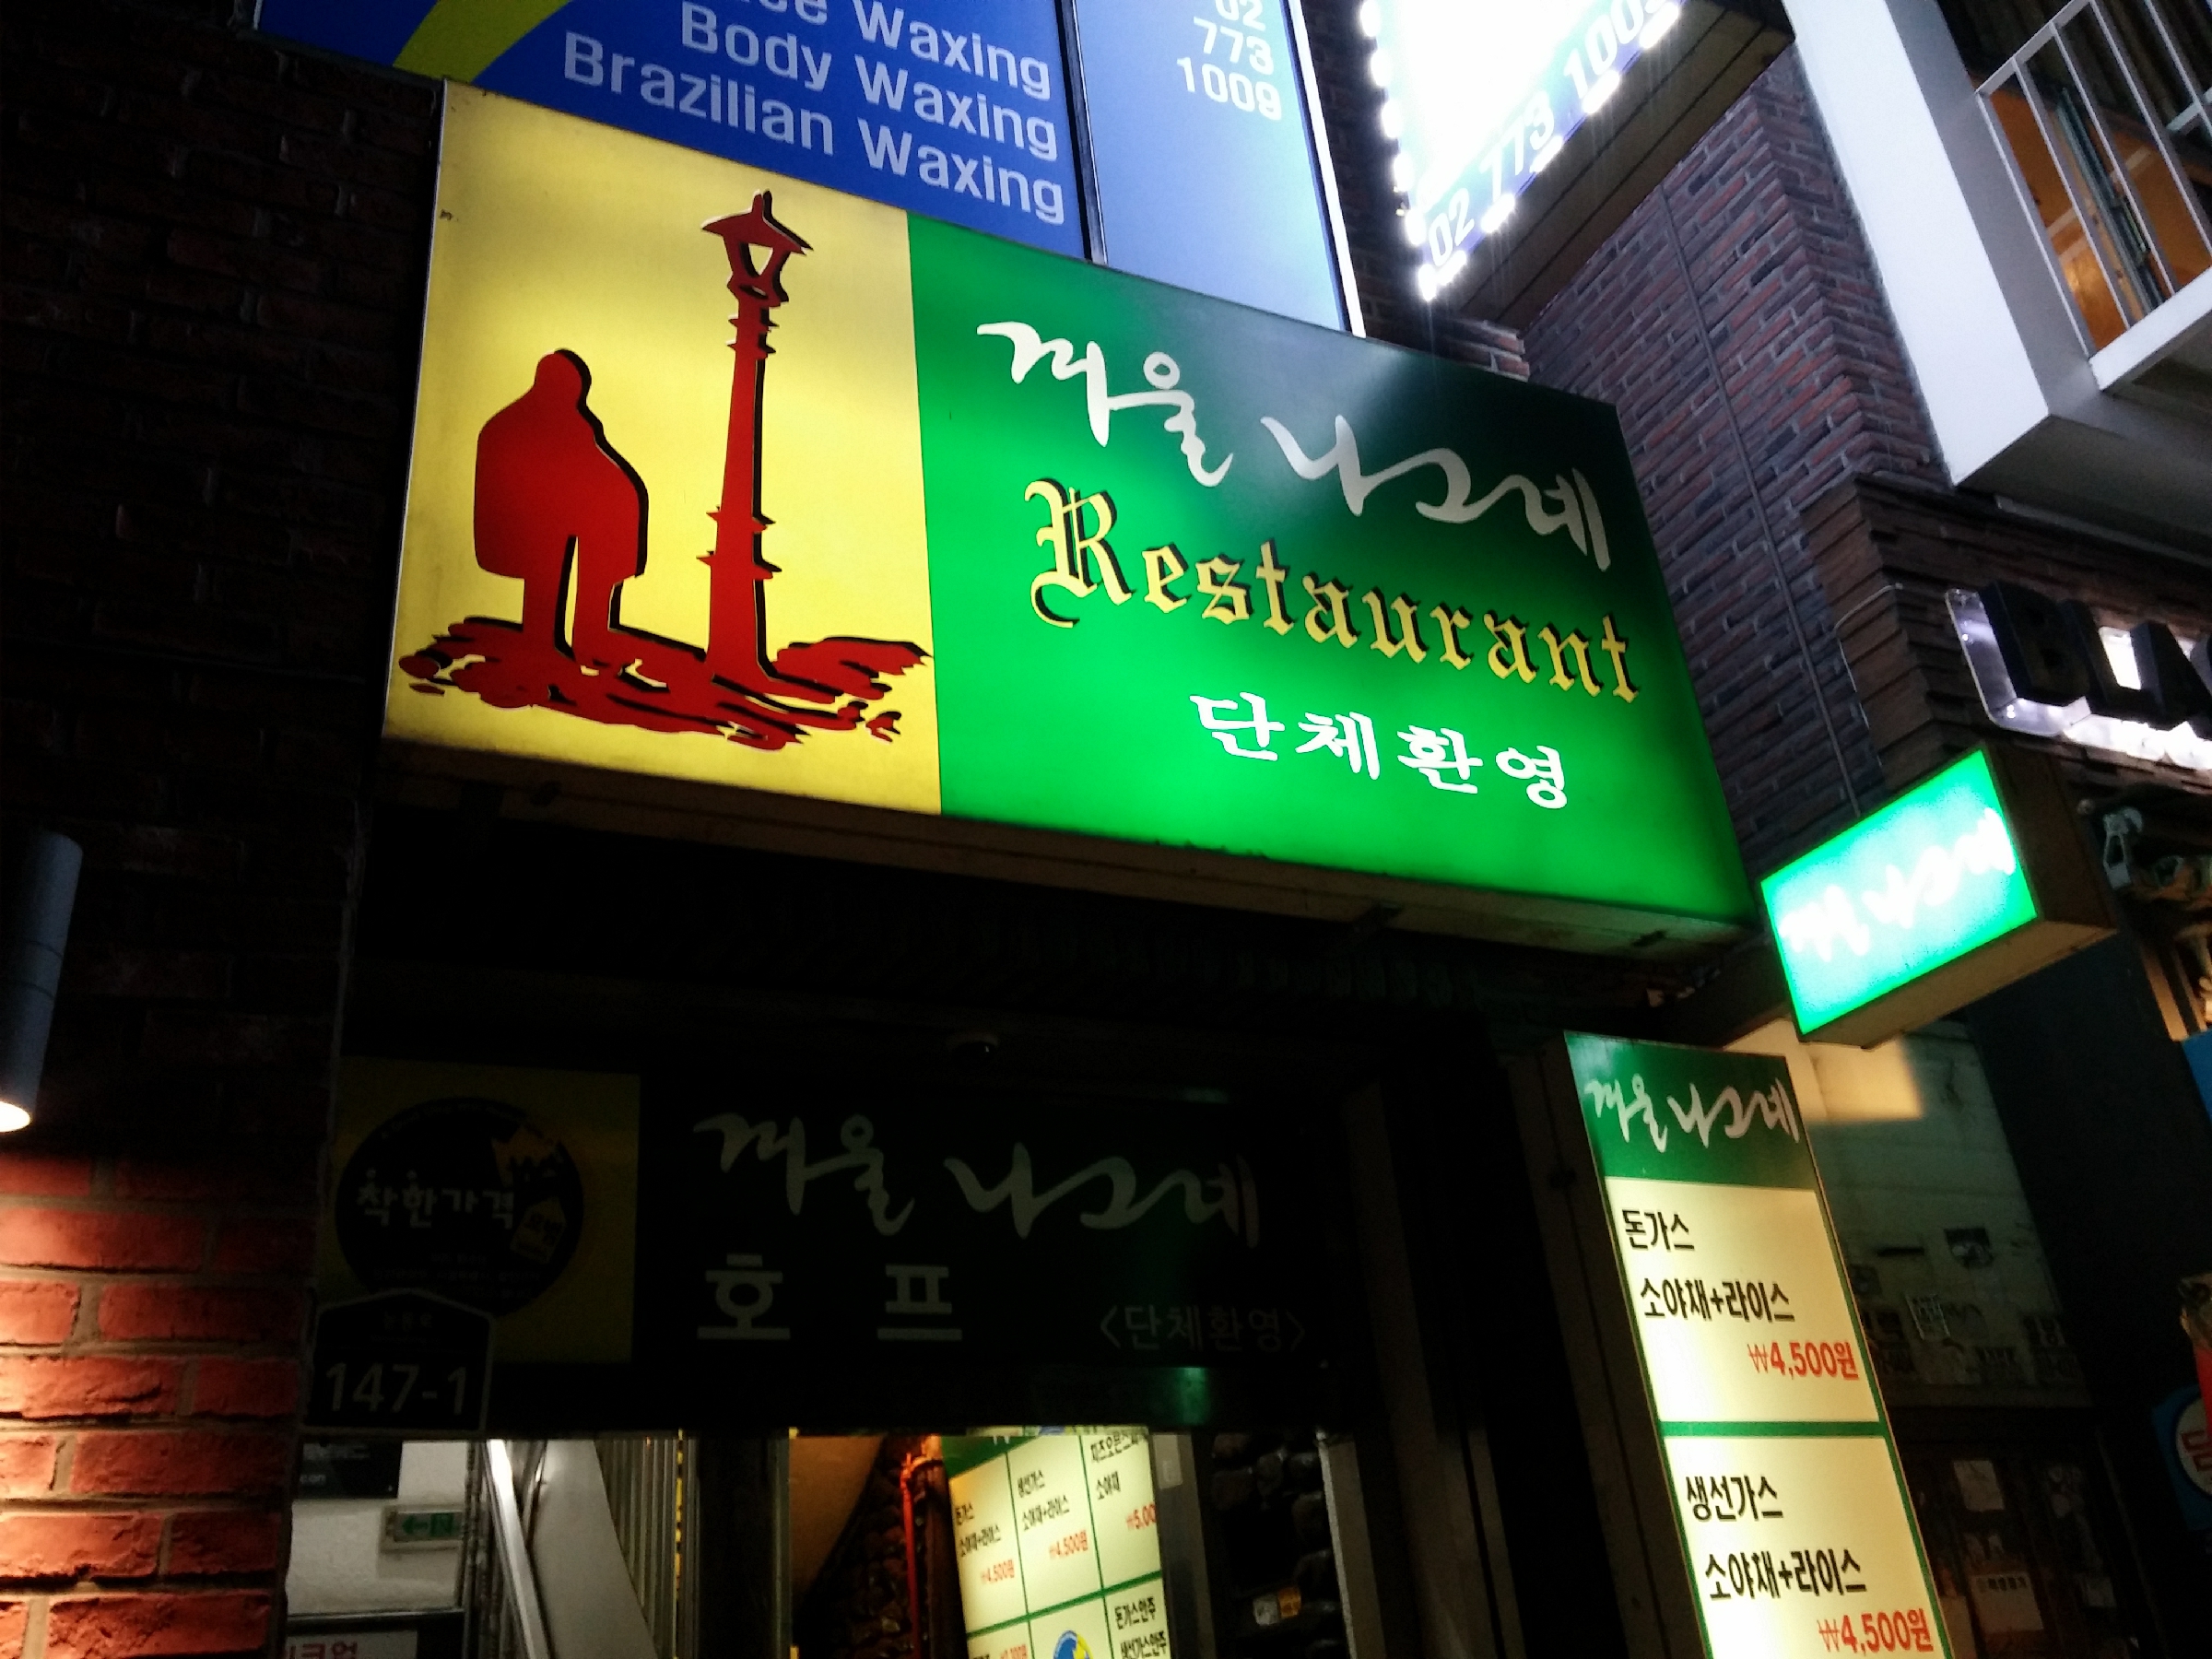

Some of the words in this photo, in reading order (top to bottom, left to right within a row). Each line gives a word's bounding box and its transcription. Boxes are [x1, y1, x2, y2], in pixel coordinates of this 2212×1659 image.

[1216, 0, 1266, 32] 02
[853, 0, 1051, 100] Waxing
[1193, 16, 1275, 76] 773
[681, 1, 832, 92] Body
[854, 53, 1058, 162] Waxing
[1176, 56, 1282, 121] 1009
[564, 30, 834, 156] Brazilian
[857, 118, 1065, 226] Waxing
[1428, 187, 1475, 267] 02
[1479, 93, 1556, 202] 773
[1563, 0, 1665, 100] 100
[1023, 477, 1641, 704] Restaurant
[1189, 691, 1569, 810] 단체환영
[1622, 1208, 1696, 1252] 돈가스
[1641, 1277, 1794, 1323] 소야채+라이스
[325, 1360, 467, 1417] 147-1
[1747, 1342, 1859, 1381] ₩4,500원
[1685, 1476, 1783, 1522] 생선가스
[1705, 1549, 1867, 1601] 소야채+라이스
[1817, 1607, 1934, 1656] ₩4,500원
